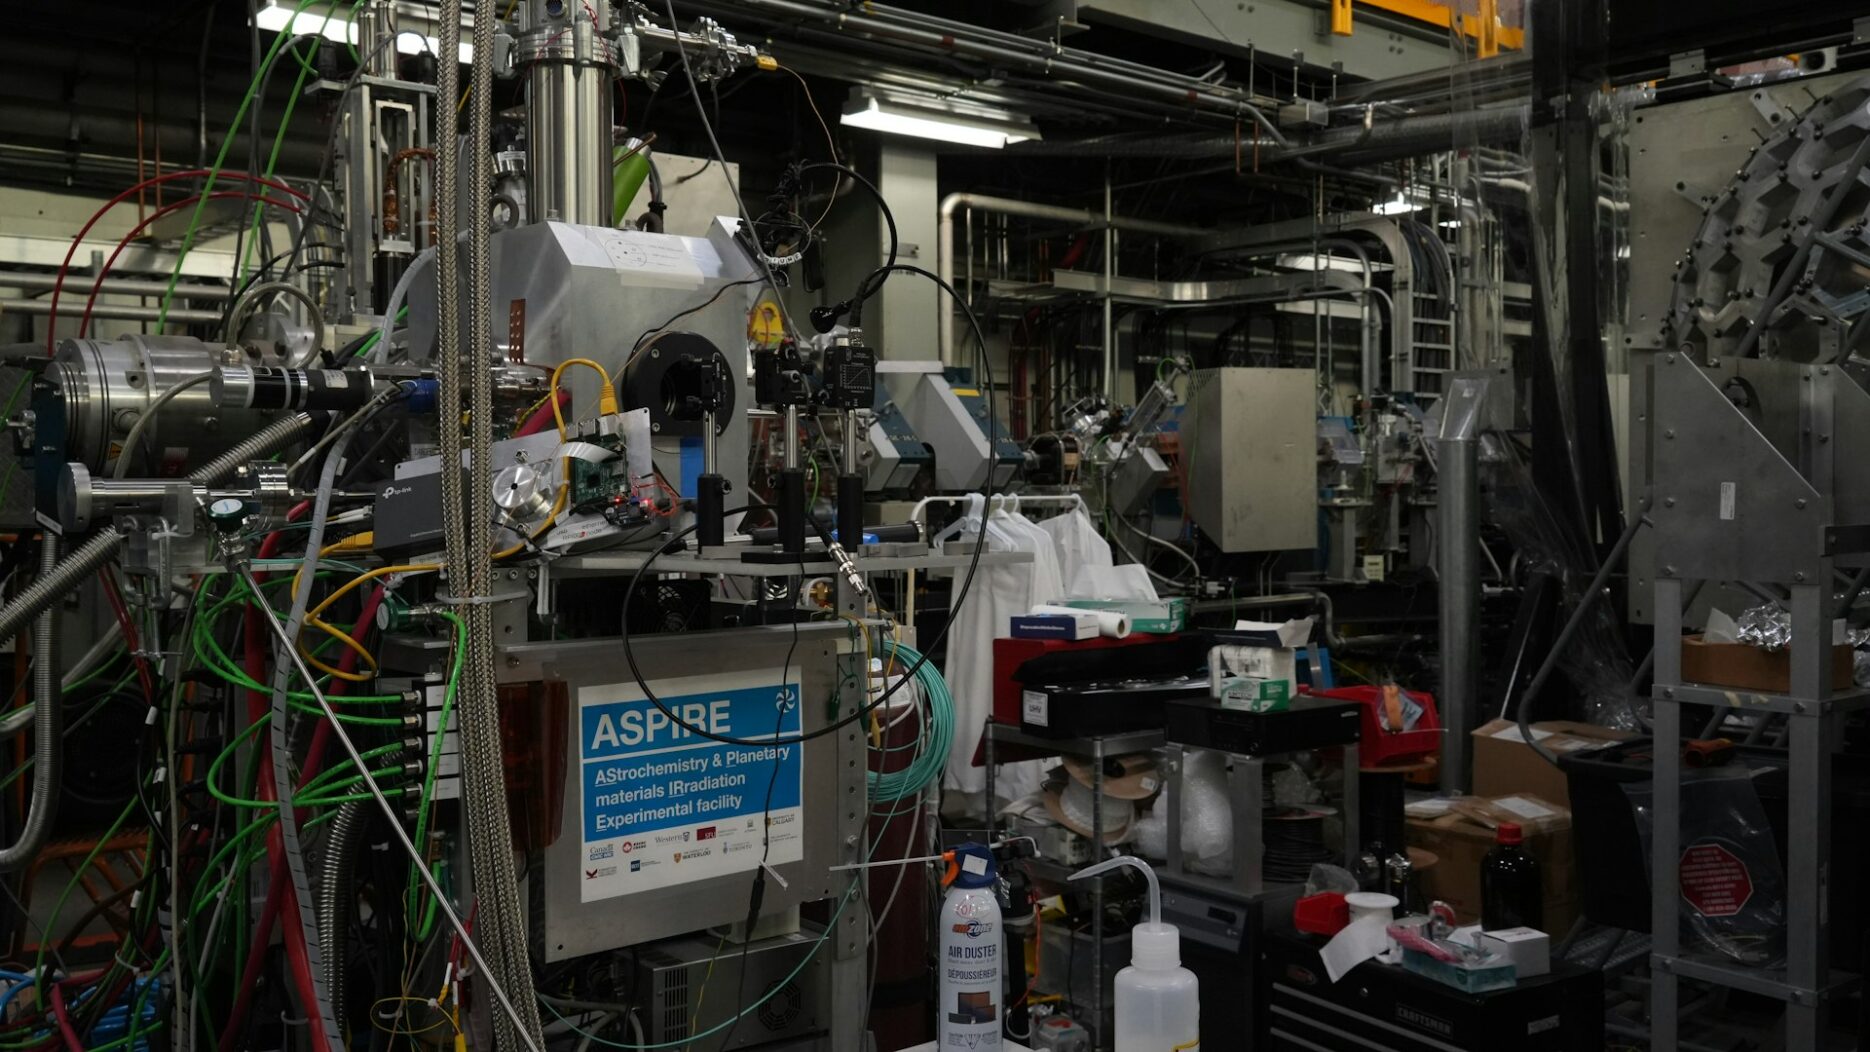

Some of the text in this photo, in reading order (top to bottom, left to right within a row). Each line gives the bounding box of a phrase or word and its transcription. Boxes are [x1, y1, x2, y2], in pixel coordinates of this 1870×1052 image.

[591, 699, 732, 750] ASPIRE
[595, 745, 791, 786] AStrochemistry & Planetary
[595, 772, 746, 808] materials IRradiation
[595, 795, 743, 832] Experimental facility
[948, 944, 997, 959] AIR DUSTER
[1397, 1007, 1451, 1034] CRAFTSMAN
